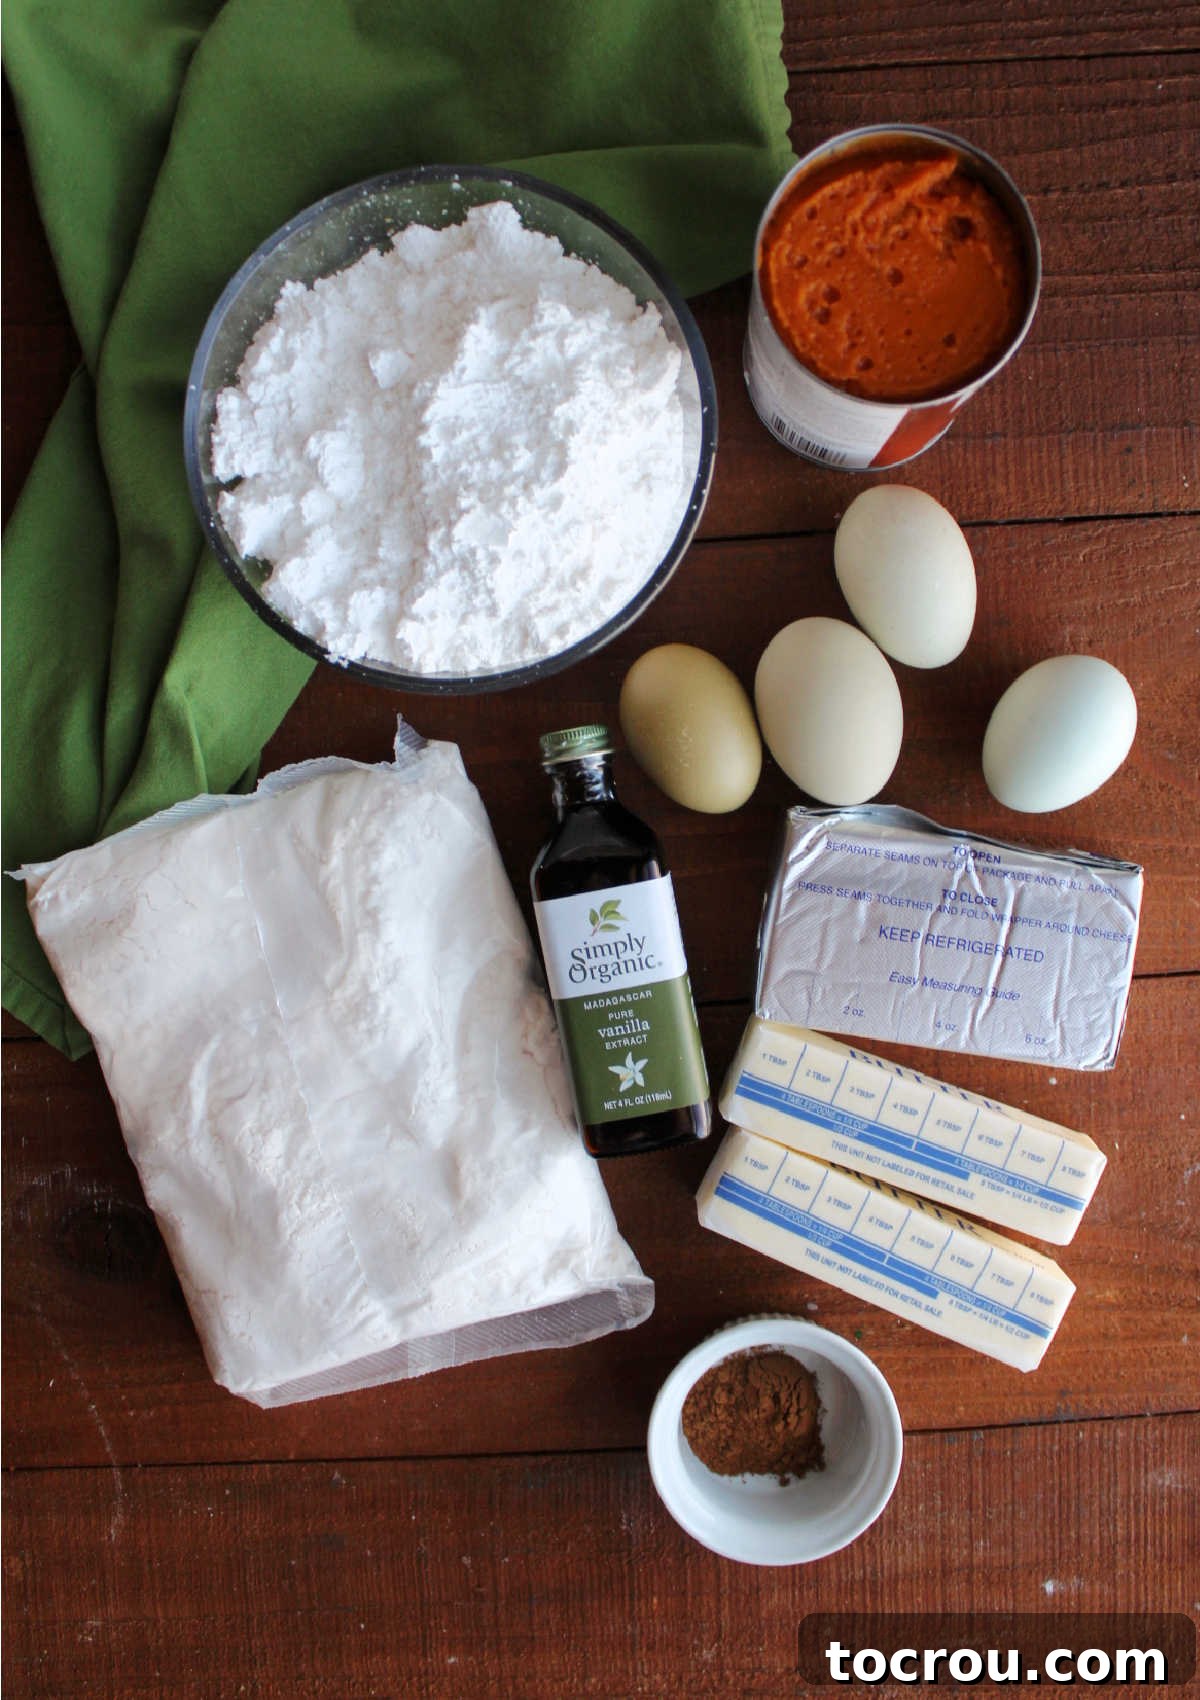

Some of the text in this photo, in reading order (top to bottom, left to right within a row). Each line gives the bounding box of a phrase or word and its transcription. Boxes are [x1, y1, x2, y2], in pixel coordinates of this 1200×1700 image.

[825, 840, 881, 858] SEPARATE
[884, 851, 920, 865] SEAMS
[923, 856, 938, 867] ON
[942, 860, 962, 871] TOP
[982, 867, 1032, 883] PACKAGE
[1036, 874, 1057, 886] AND
[953, 845, 1001, 864] TO OPEN
[942, 888, 998, 907] TO CLOSE
[798, 880, 833, 895] PRESS
[837, 887, 872, 902] SEAMS
[877, 893, 933, 912] TOGETHER
[936, 904, 958, 915] AND
[960, 907, 989, 920] FOLD
[1045, 921, 1090, 936] AROUND
[571, 933, 646, 967] Simply
[879, 924, 1044, 963] KEEP REFRIGERATED
[568, 954, 656, 984] Organic
[889, 970, 1020, 1001] Easy Measuring Guide
[584, 990, 653, 1010] MADAGASCAR
[843, 1005, 850, 1015] 2
[608, 1009, 634, 1021] PURE
[935, 1020, 941, 1028] 4
[598, 1018, 650, 1038] vanilla
[605, 1034, 648, 1050] EXTRACT
[603, 1100, 617, 1110] NET
[635, 1095, 644, 1105] OZ
[867, 1153, 881, 1164] NOT
[882, 1160, 915, 1176] LABELED
[915, 1172, 931, 1183] FOR
[931, 1178, 955, 1191] RETAIL
[956, 1188, 975, 1199] SALE
[1050, 1205, 1065, 1214] CUP
[837, 1263, 853, 1275] NOT
[853, 1271, 885, 1289] LABELED
[884, 1285, 900, 1297] FOR
[900, 1293, 923, 1308] RETAIL
[924, 1305, 942, 1317] SALE
[1014, 1329, 1030, 1341] CUP
